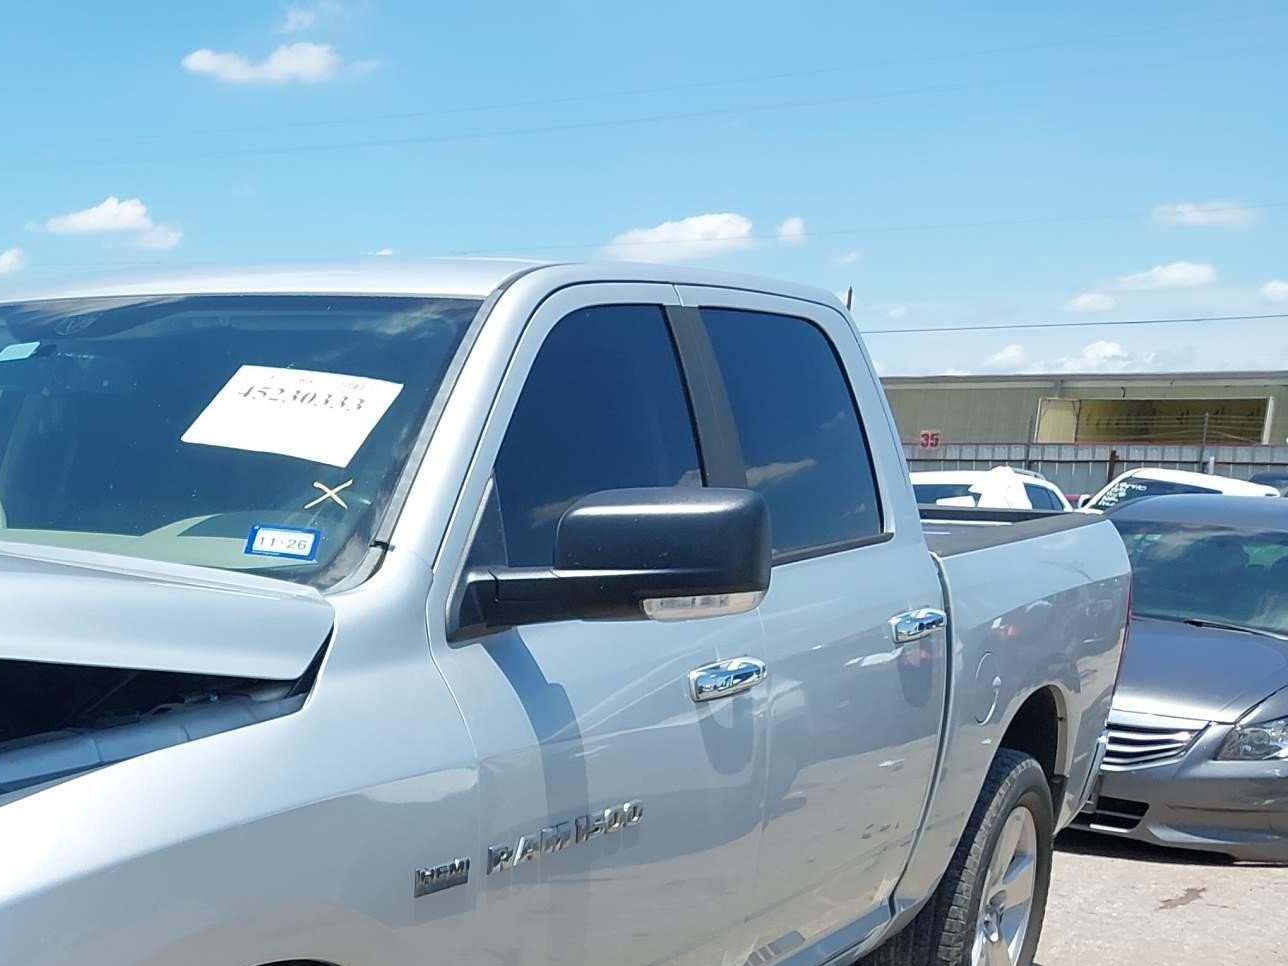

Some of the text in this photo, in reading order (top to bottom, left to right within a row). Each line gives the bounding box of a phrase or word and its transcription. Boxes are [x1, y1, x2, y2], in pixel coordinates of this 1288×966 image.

[237, 385, 365, 412] 45230333
[920, 432, 940, 447] 35
[487, 799, 644, 876] RAM 1500
